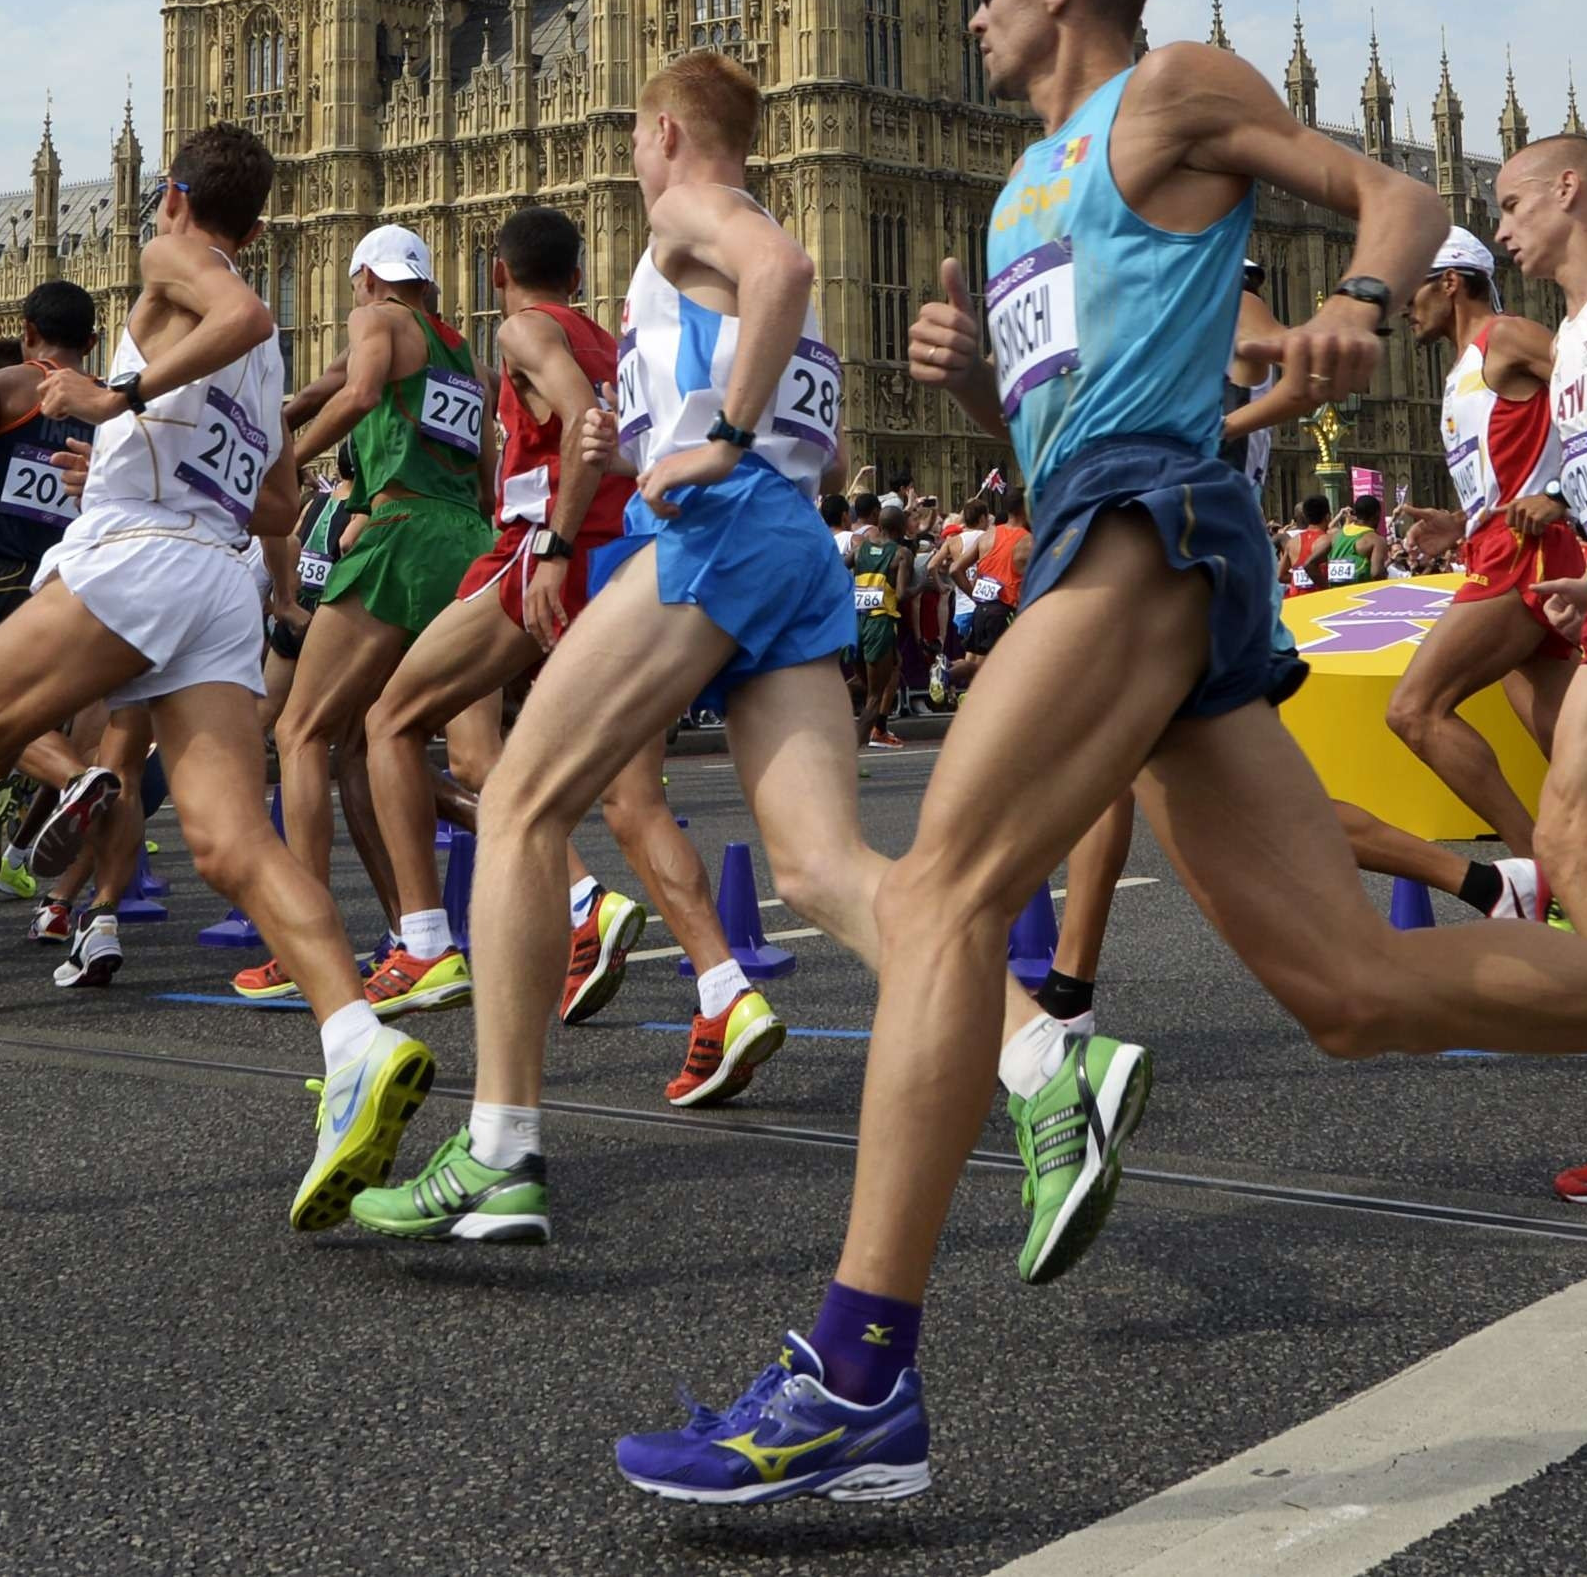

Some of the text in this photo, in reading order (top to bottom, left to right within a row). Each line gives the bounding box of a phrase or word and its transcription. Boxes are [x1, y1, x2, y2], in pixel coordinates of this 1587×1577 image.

[429, 390, 481, 437] 270
[1330, 565, 1352, 577] 684
[975, 583, 996, 599] 2409
[856, 593, 880, 607] 786
